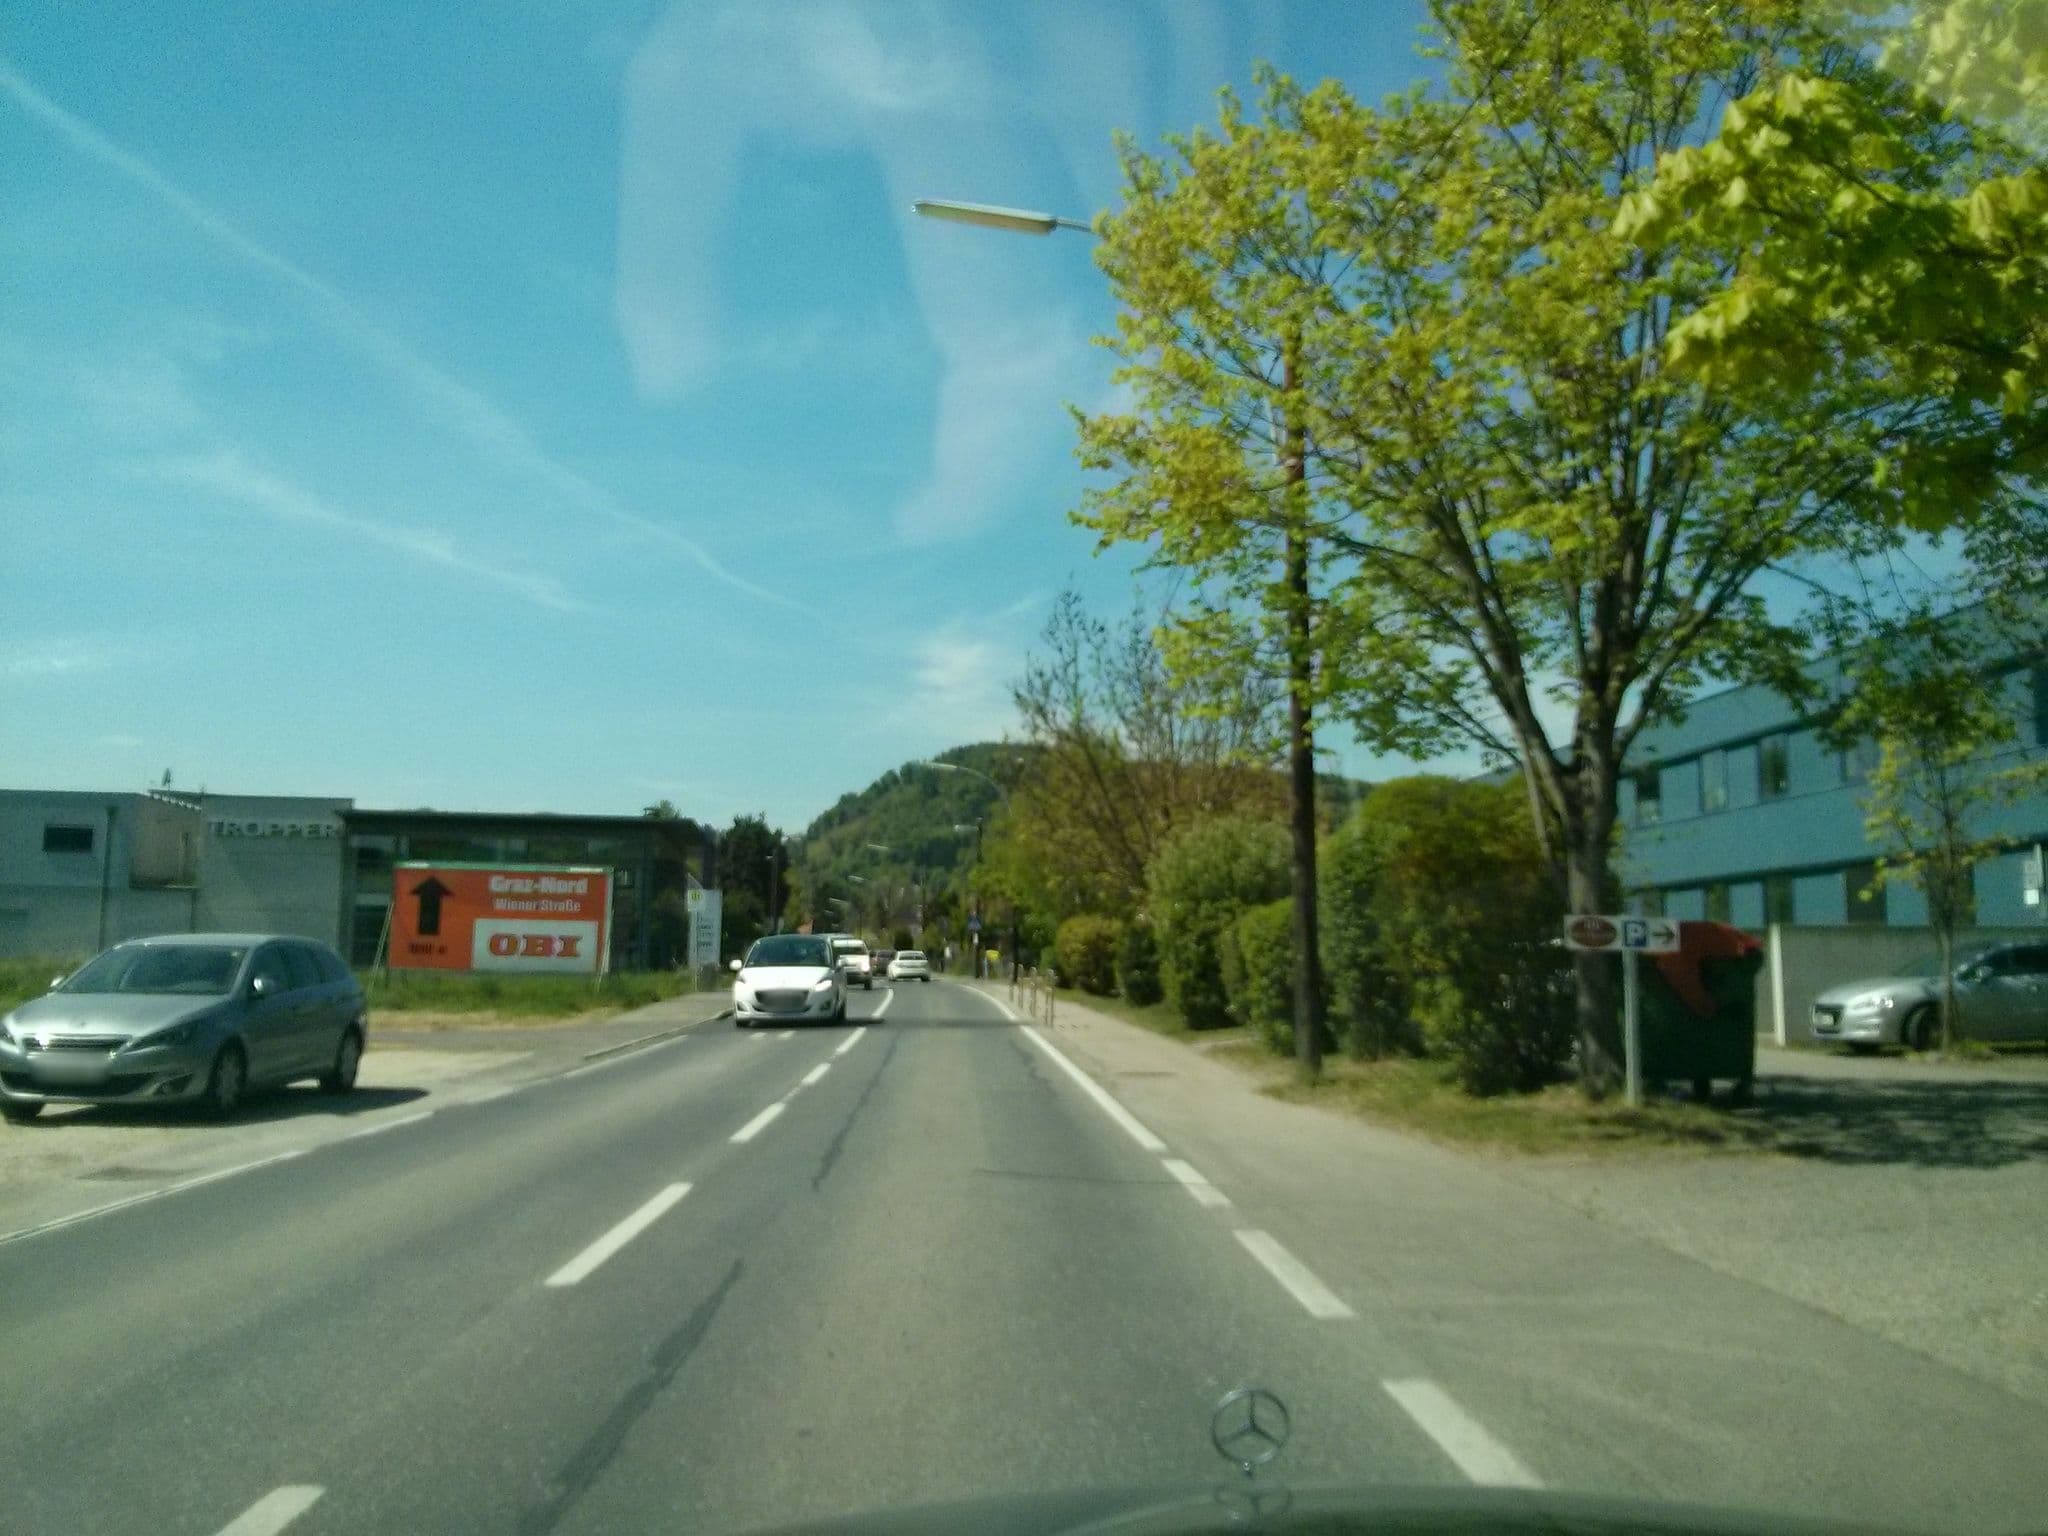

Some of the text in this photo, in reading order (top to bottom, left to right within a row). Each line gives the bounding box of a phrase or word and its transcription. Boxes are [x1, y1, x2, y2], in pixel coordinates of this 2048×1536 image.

[209, 820, 338, 838] TROPPER
[490, 875, 588, 893] Graz-Nord
[495, 899, 581, 914] Wiener Straße
[1627, 923, 1644, 946] P
[490, 934, 580, 957] OBI
